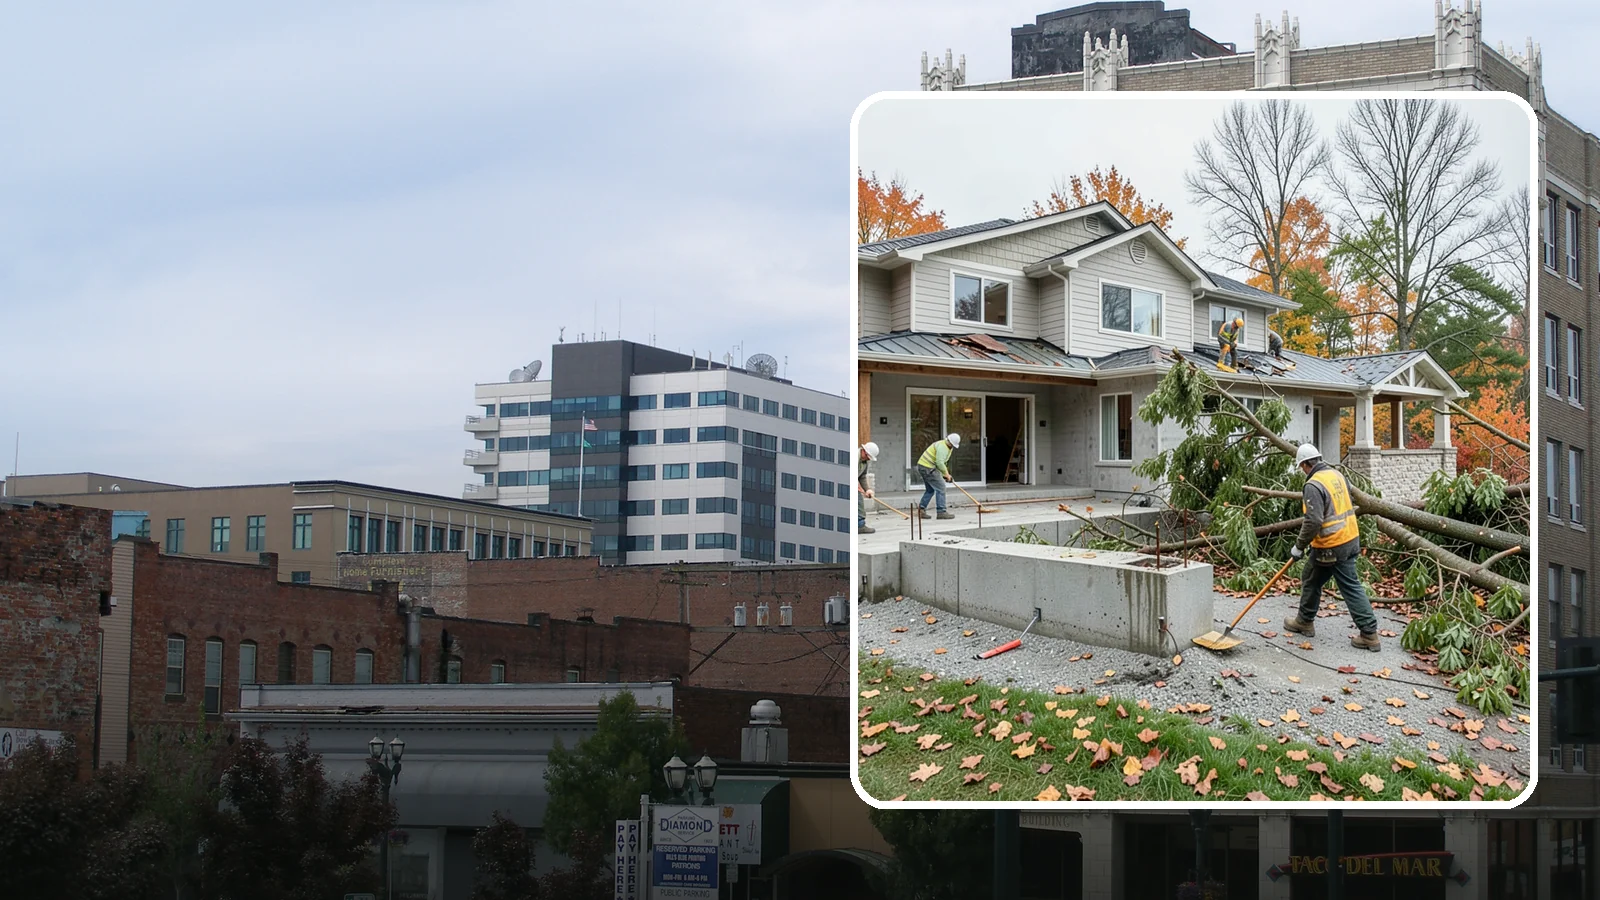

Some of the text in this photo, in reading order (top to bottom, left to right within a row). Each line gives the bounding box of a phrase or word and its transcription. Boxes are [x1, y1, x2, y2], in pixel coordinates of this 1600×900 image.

[343, 566, 427, 577] Home Furnishers
[660, 818, 713, 833] DIAMOND
[1022, 816, 1070, 827] BUILDING
[655, 845, 716, 854] RESERVED PARKING
[616, 824, 625, 894] PAY HERE
[628, 824, 636, 893] PAY HERE
[721, 851, 739, 863] Soup
[671, 862, 701, 870] PATRONS
[1346, 856, 1386, 875] DEL
[1392, 857, 1443, 877] MAR
[660, 888, 710, 899] PUBLIC PARKING
